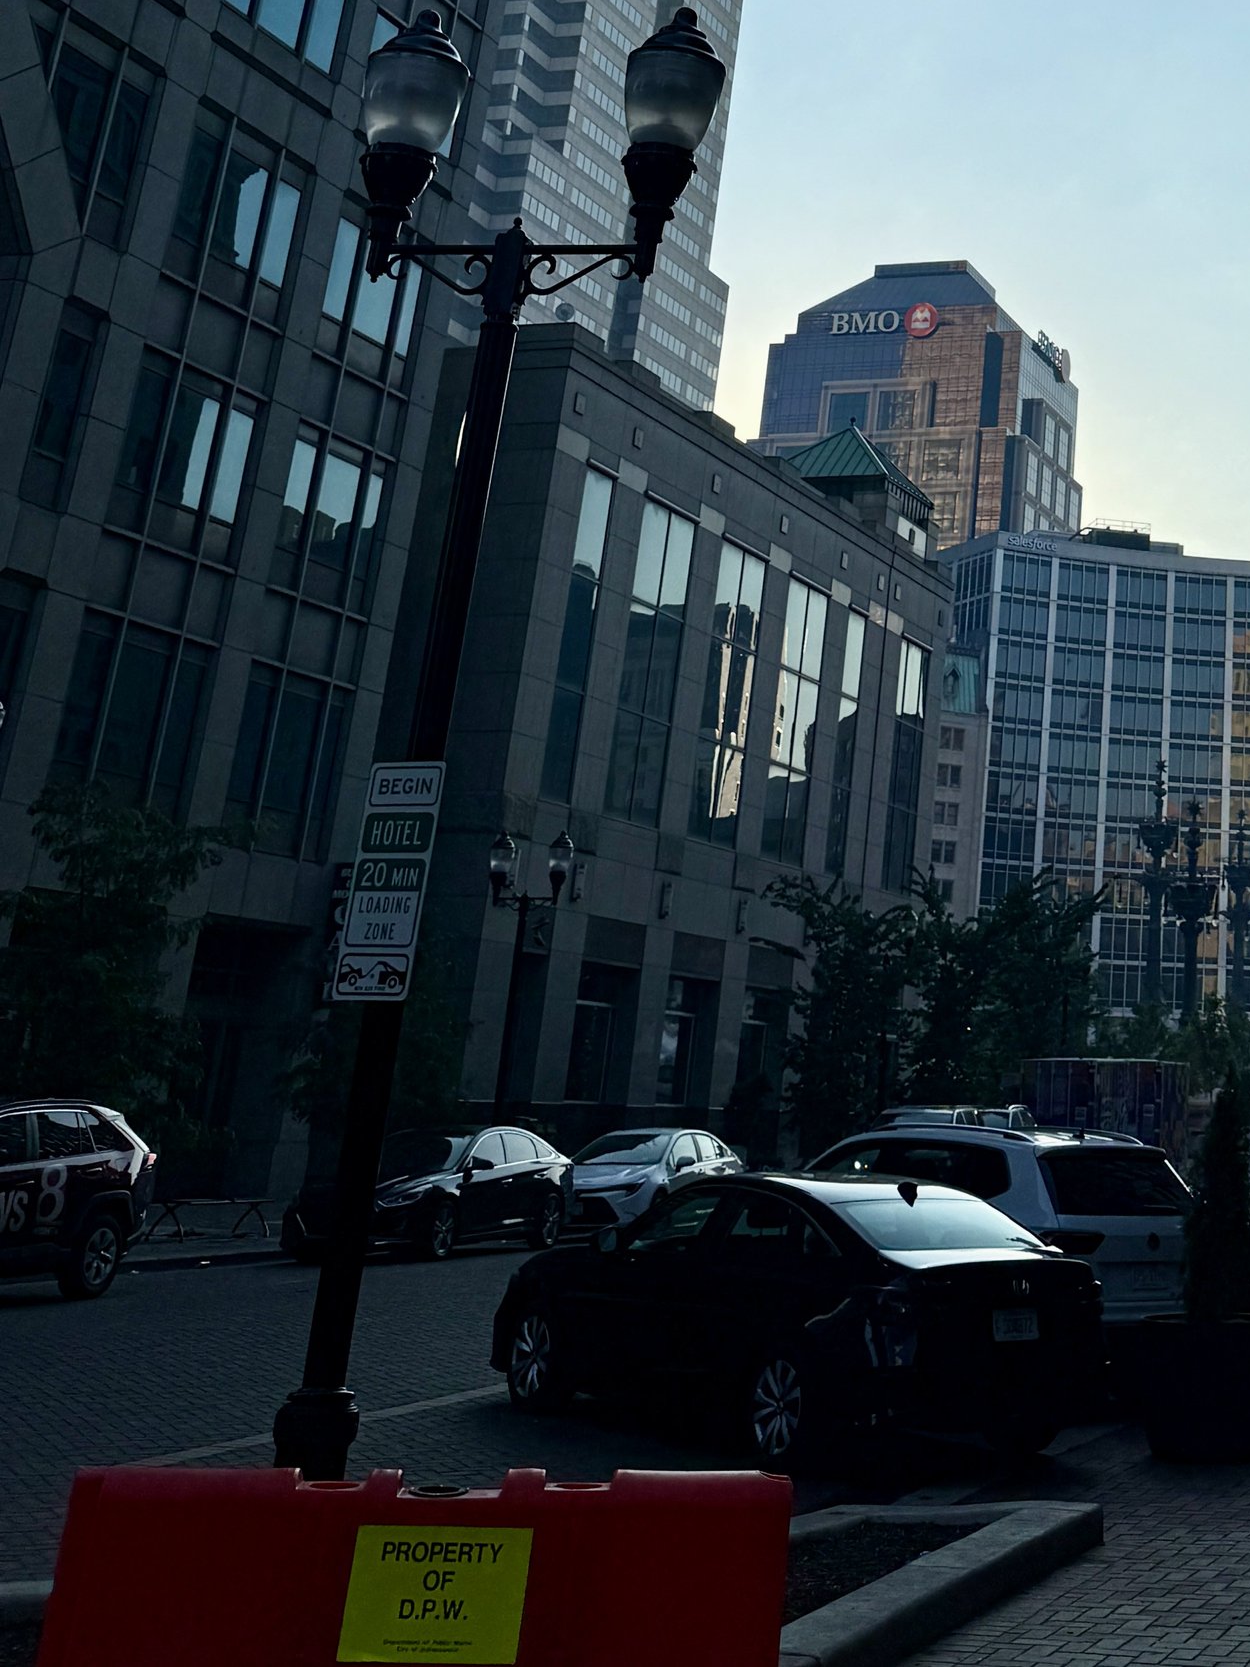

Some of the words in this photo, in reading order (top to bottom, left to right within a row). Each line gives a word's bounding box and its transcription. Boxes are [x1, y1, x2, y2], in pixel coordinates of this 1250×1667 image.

[829, 310, 900, 334] BMO
[1007, 534, 1058, 552] salesforce
[378, 777, 434, 795] BEGIN
[370, 820, 422, 845] HOTEL
[360, 861, 387, 887] 20
[391, 867, 420, 887] MIN
[358, 896, 412, 914] LOADING
[364, 922, 396, 940] ZONE
[36, 1164, 68, 1223] 8
[381, 1541, 504, 1563] PROPERTY
[423, 1570, 455, 1591] OF
[398, 1599, 468, 1620] D.P.W.
